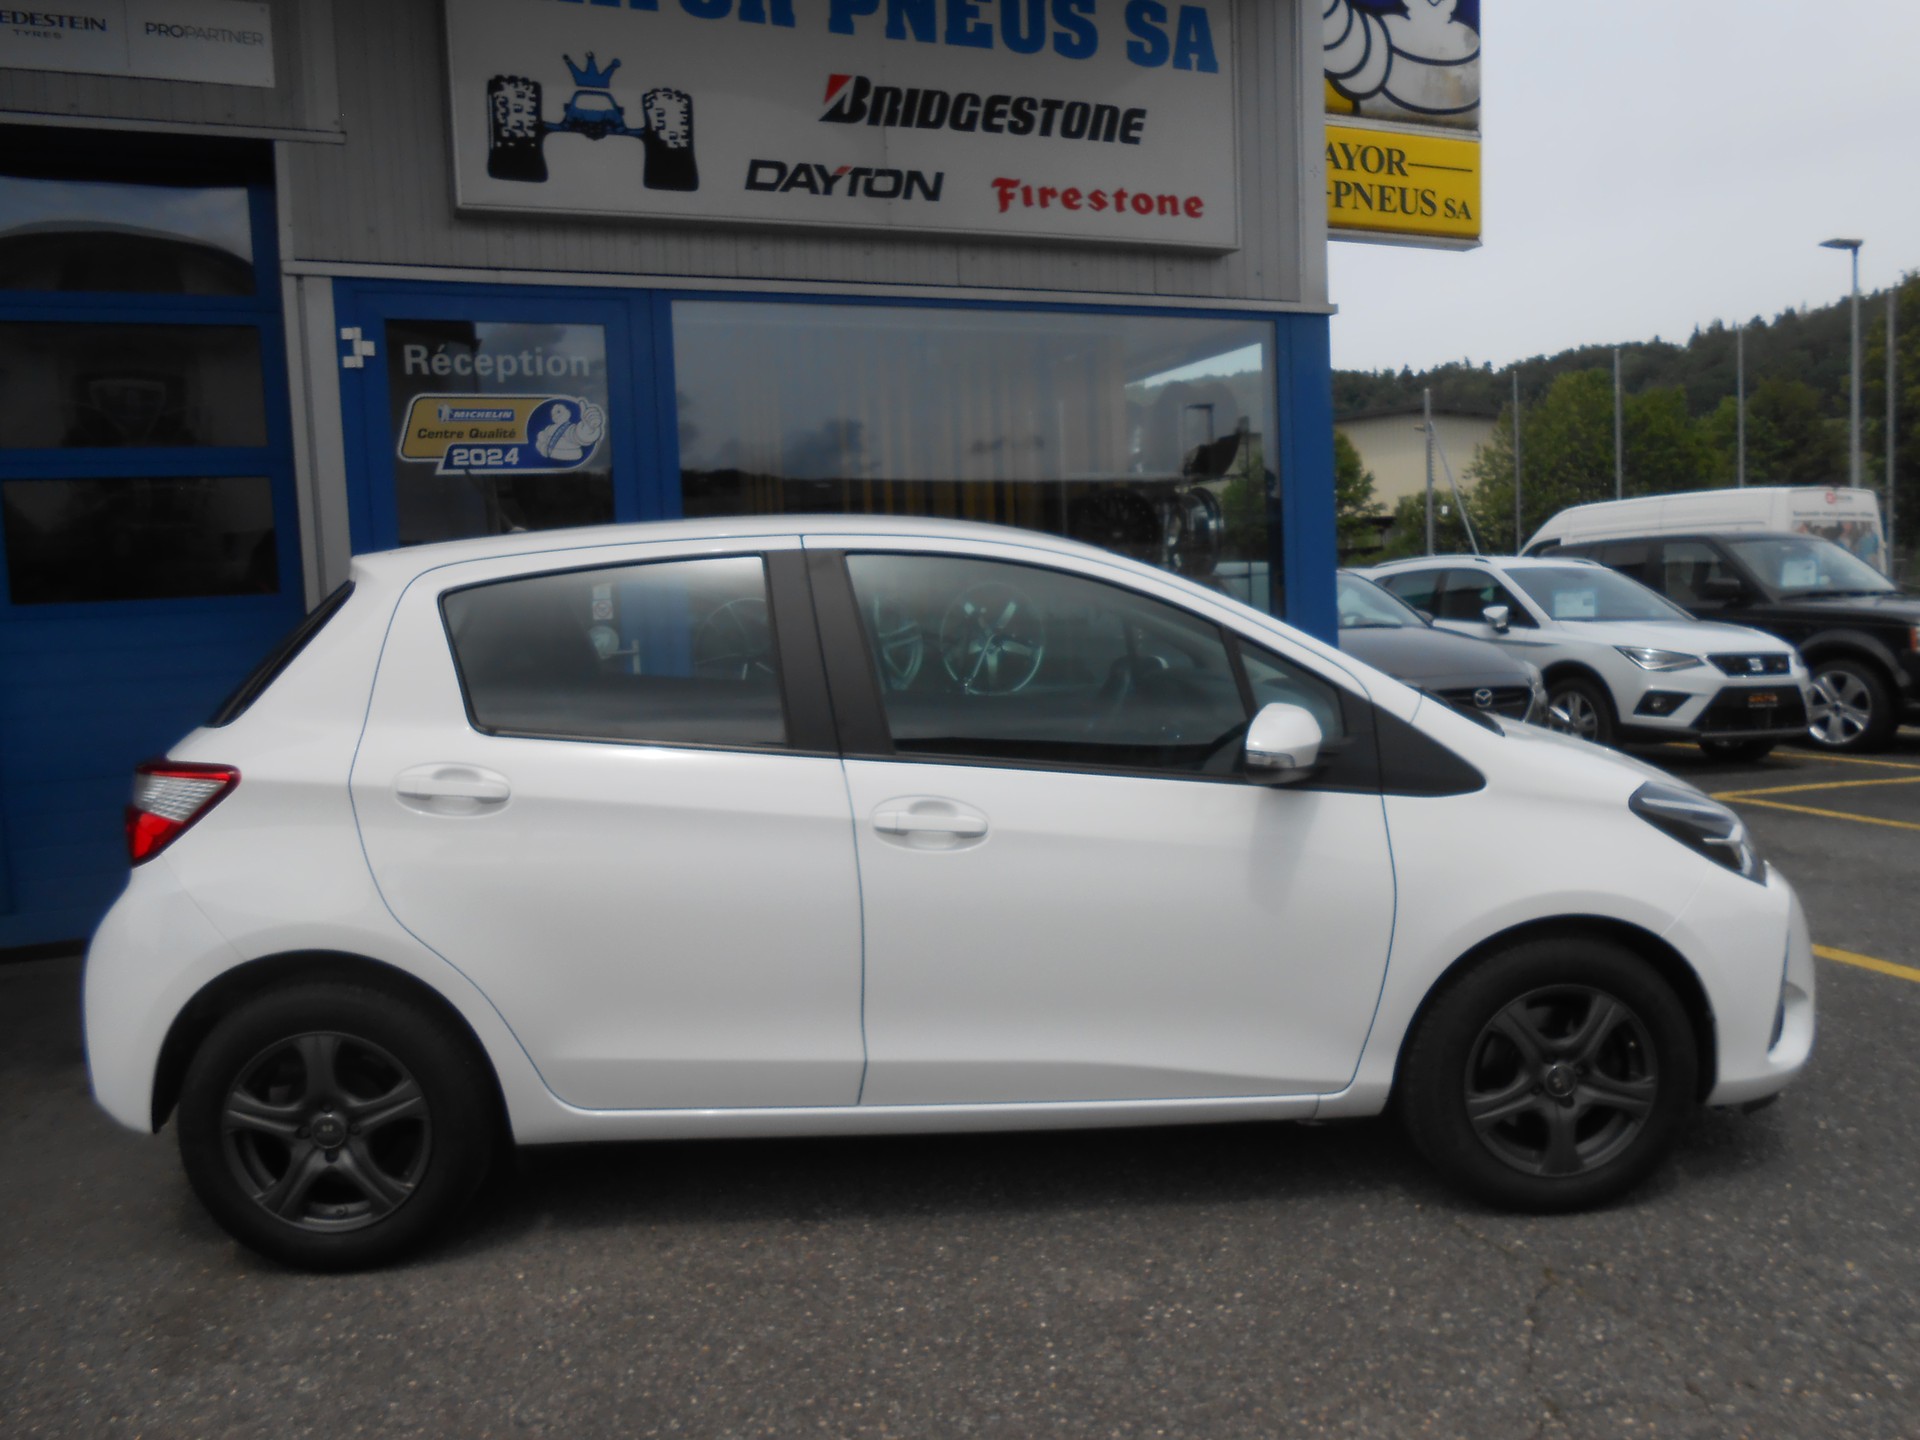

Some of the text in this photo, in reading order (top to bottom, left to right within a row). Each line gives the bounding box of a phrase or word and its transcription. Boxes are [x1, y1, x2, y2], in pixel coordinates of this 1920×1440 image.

[13, 29, 62, 40] TYRES
[145, 22, 264, 46] PROPARTNER
[1125, 0, 1220, 74] SA
[820, 74, 1147, 145] BRIDGESTONE
[745, 159, 944, 202] DAYTON
[992, 177, 1205, 219] Firestone
[1444, 198, 1472, 220] SA
[403, 344, 590, 383] Réception
[453, 410, 513, 419] MICHELIN
[417, 428, 516, 439] Centre Qualité
[452, 448, 519, 466] 2024
